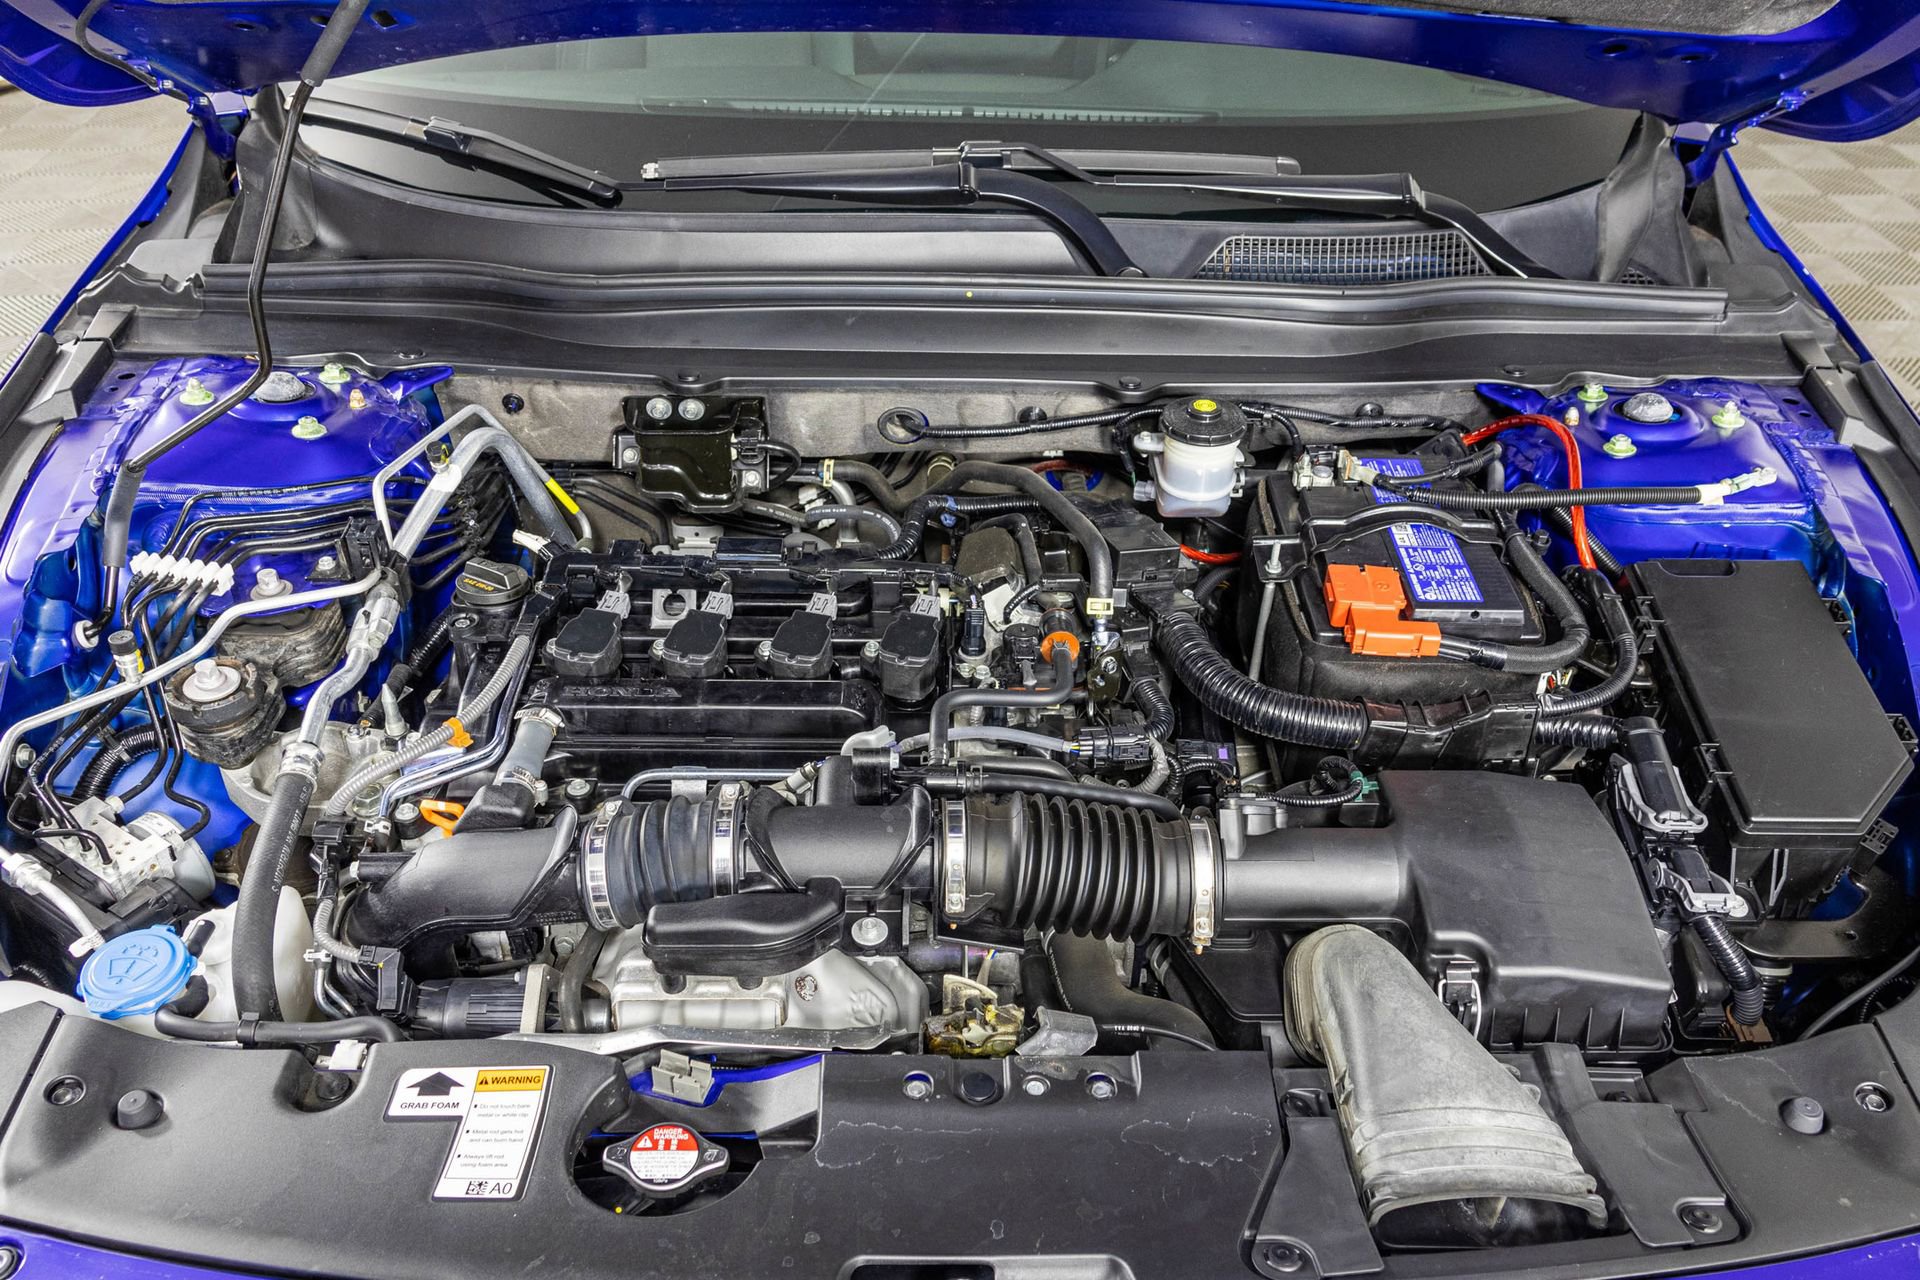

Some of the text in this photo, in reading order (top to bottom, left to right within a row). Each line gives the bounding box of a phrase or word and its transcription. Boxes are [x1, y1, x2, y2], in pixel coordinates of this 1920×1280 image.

[463, 577, 477, 587] SAE
[560, 685, 683, 698] HONDA
[491, 1075, 541, 1085] WARNING
[489, 1182, 512, 1195] A0
